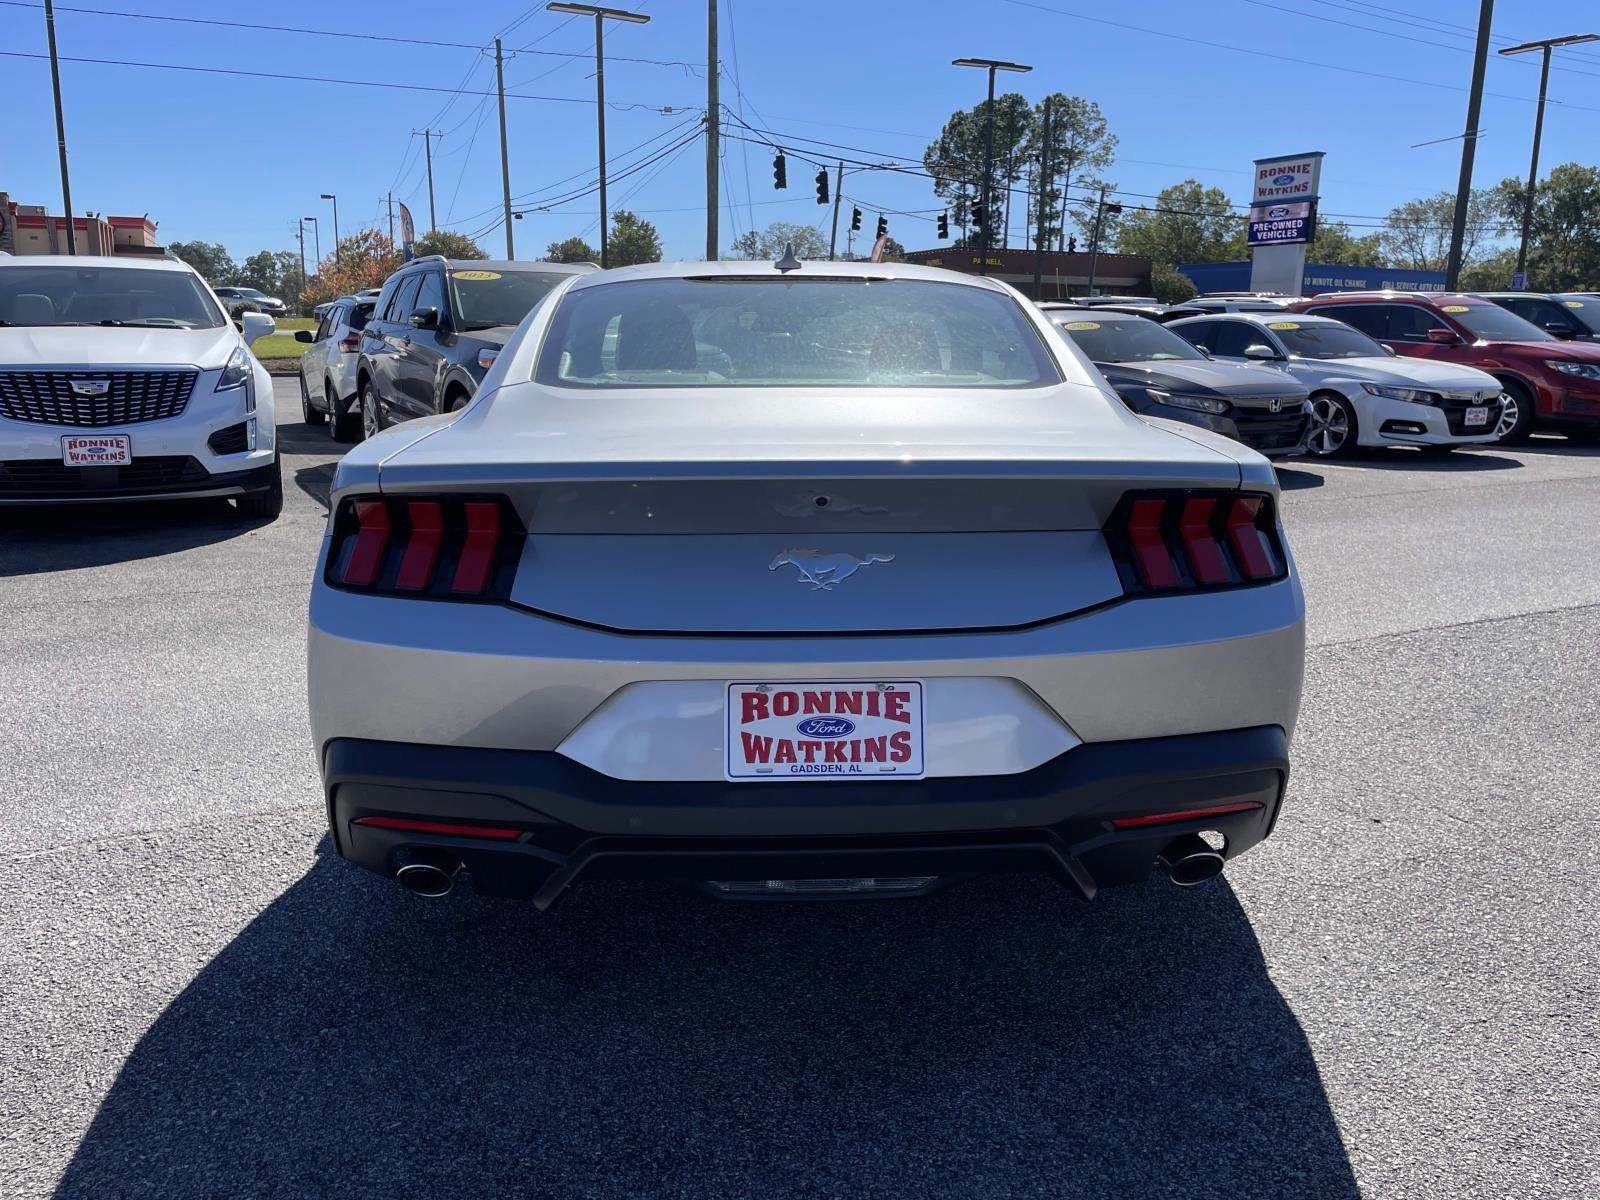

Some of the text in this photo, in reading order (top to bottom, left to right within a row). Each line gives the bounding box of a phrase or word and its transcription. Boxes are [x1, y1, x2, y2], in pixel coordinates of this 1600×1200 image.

[1259, 163, 1311, 180] RONNIE
[1258, 181, 1309, 197] WATKINS
[1253, 219, 1303, 232] PRE-OWNED
[1257, 229, 1298, 240] VEHICLES
[973, 257, 1002, 266] PANELL
[1312, 278, 1334, 287] MINUTE
[1334, 279, 1344, 287] OIL
[1345, 279, 1368, 288] CHANGE
[1381, 280, 1397, 289] FULL
[1397, 281, 1418, 290] SERVICE
[1419, 282, 1433, 291] AUTO
[68, 439, 124, 450] RONNIE
[69, 451, 126, 461] WATKINS
[741, 691, 911, 725] RONNIE
[806, 719, 848, 735] Ford
[741, 730, 912, 764] WATKINS
[790, 764, 863, 774] GADSDEN, AL
